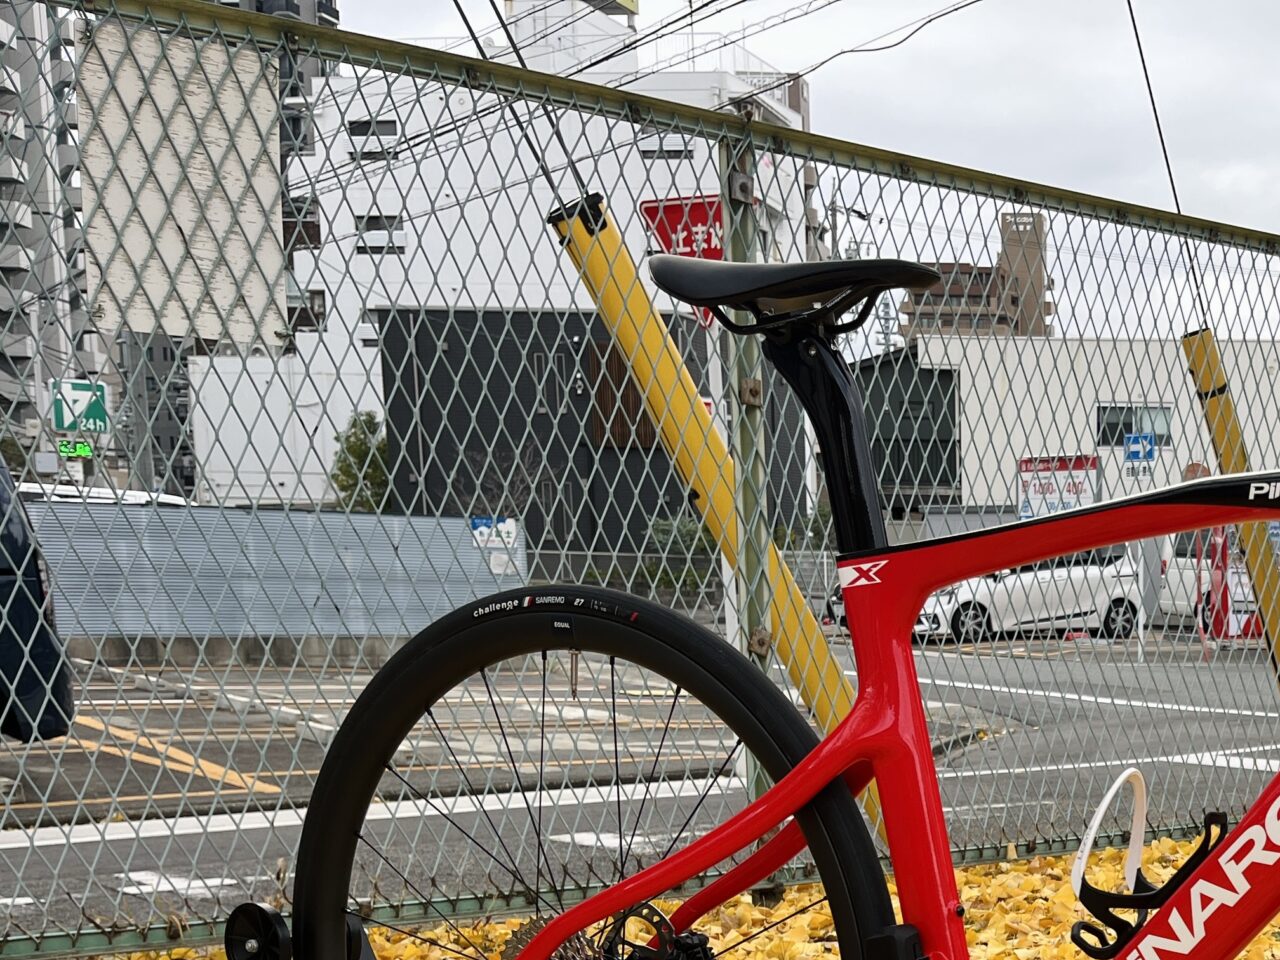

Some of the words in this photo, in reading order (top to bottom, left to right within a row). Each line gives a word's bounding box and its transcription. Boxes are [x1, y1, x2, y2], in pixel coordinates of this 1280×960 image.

[473, 599, 519, 617] challenge
[535, 596, 565, 604] SANREMO
[573, 598, 585, 607] 27
[554, 621, 571, 629] EQUAL
